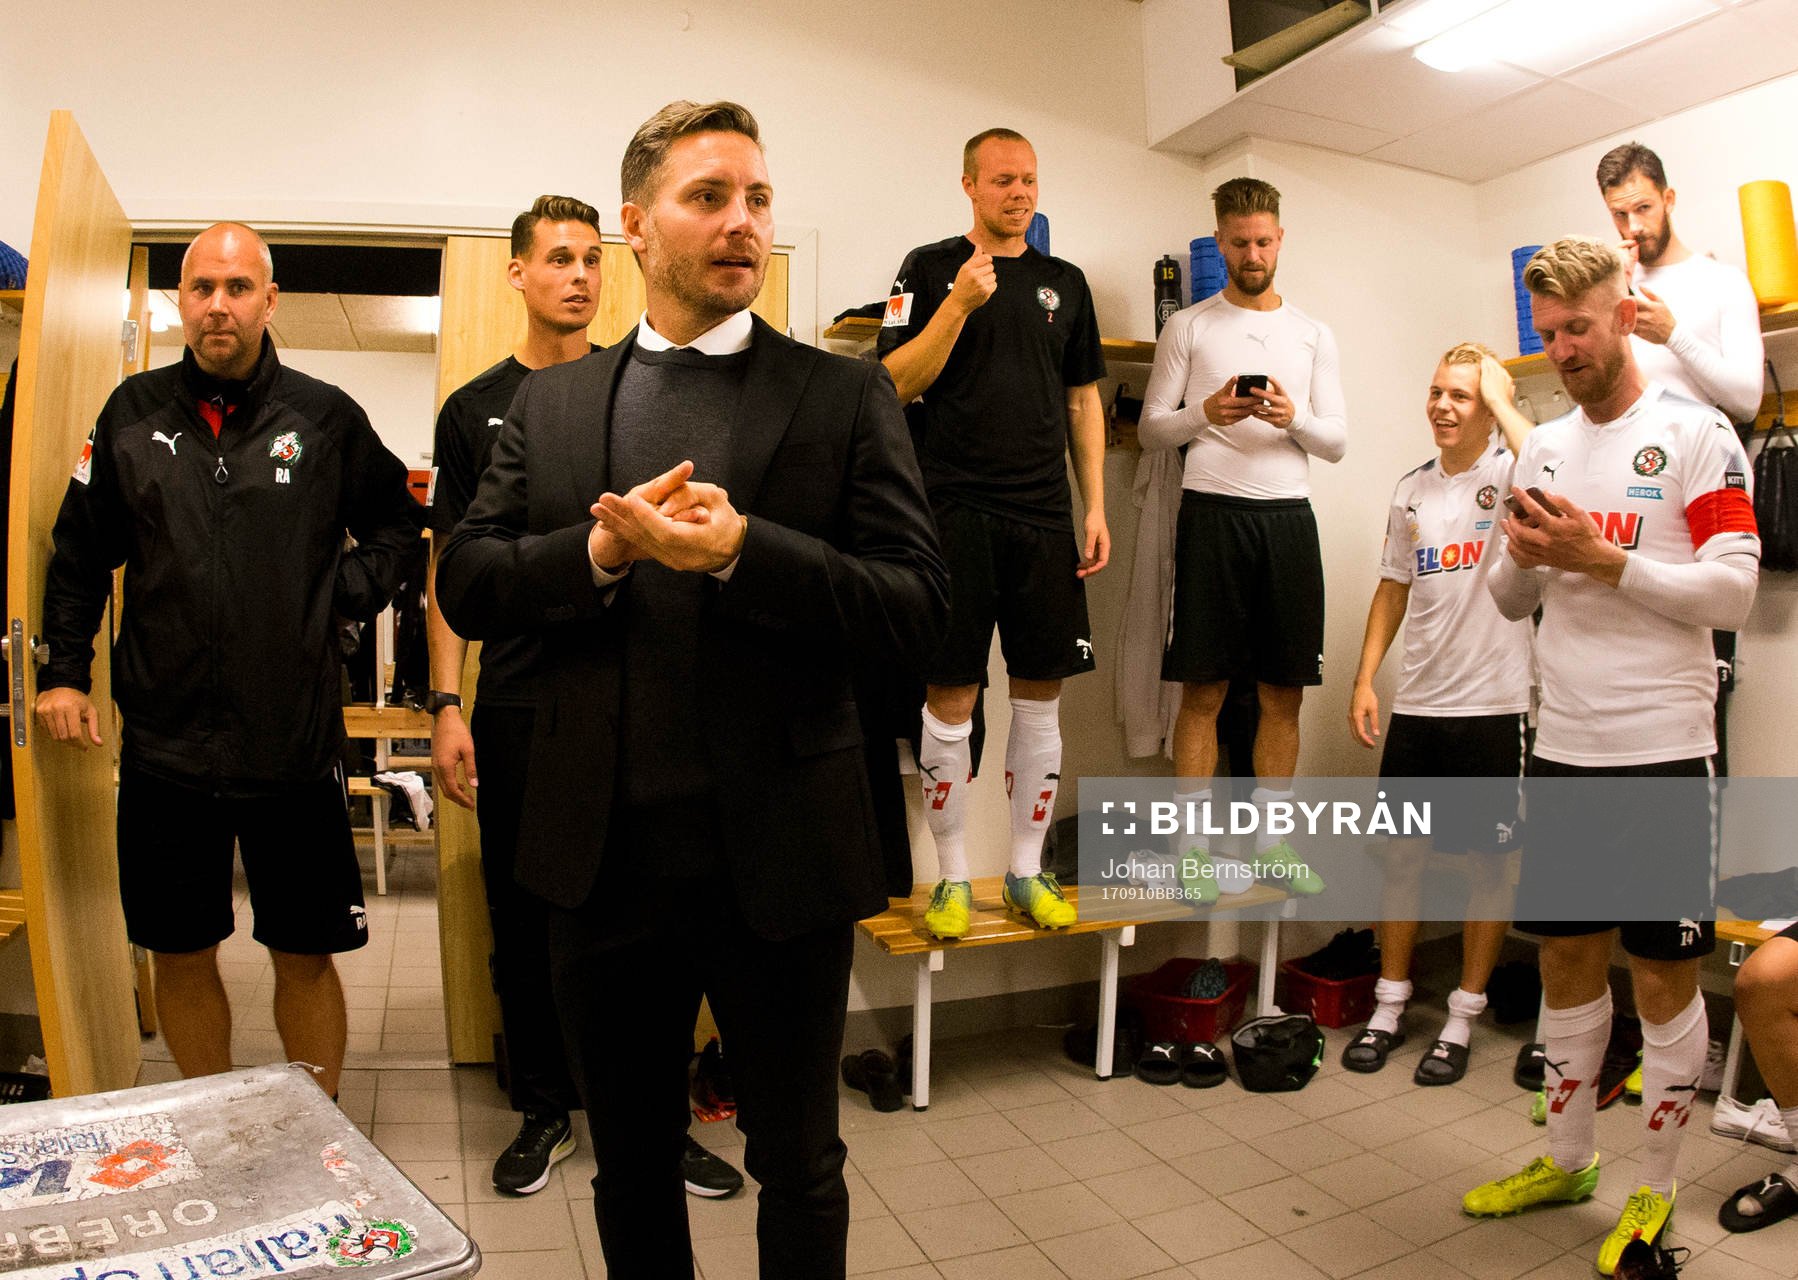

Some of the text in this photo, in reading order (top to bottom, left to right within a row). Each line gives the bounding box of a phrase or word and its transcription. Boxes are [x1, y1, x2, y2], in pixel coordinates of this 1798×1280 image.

[1163, 267, 1174, 280] 15
[1047, 311, 1054, 323] 2
[275, 467, 290, 483] RA
[1415, 540, 1484, 575] ELON
[1083, 647, 1089, 659] 2
[1681, 930, 1694, 946] 14
